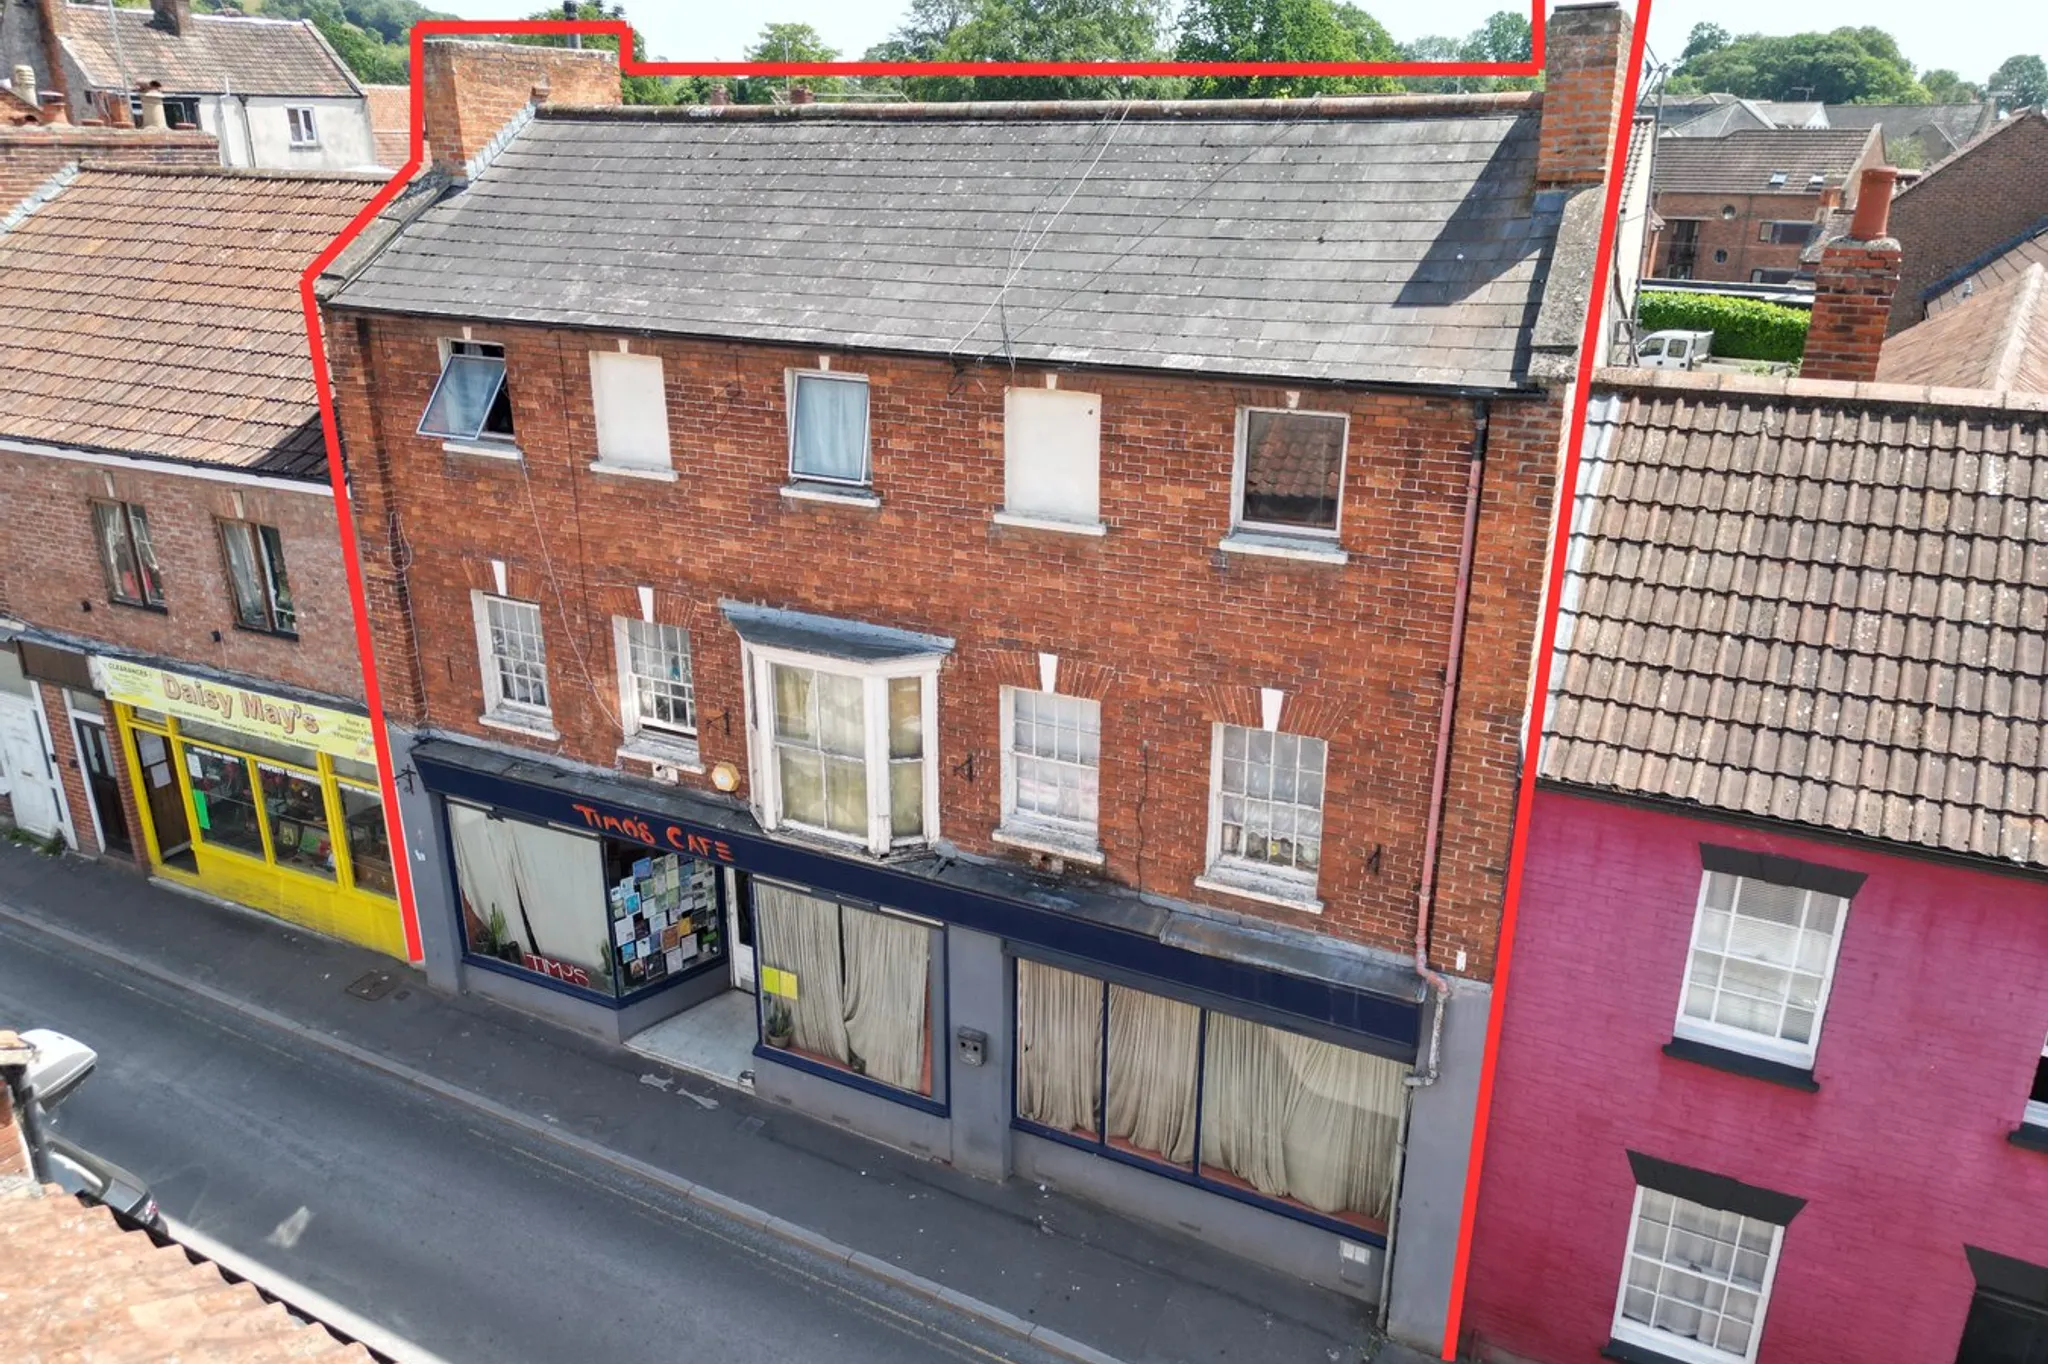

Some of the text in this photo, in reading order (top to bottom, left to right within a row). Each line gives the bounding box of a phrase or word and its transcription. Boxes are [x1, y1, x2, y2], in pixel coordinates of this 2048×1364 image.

[162, 672, 233, 719] Daisy
[239, 690, 320, 734] May's
[666, 826, 735, 862] CAFE
